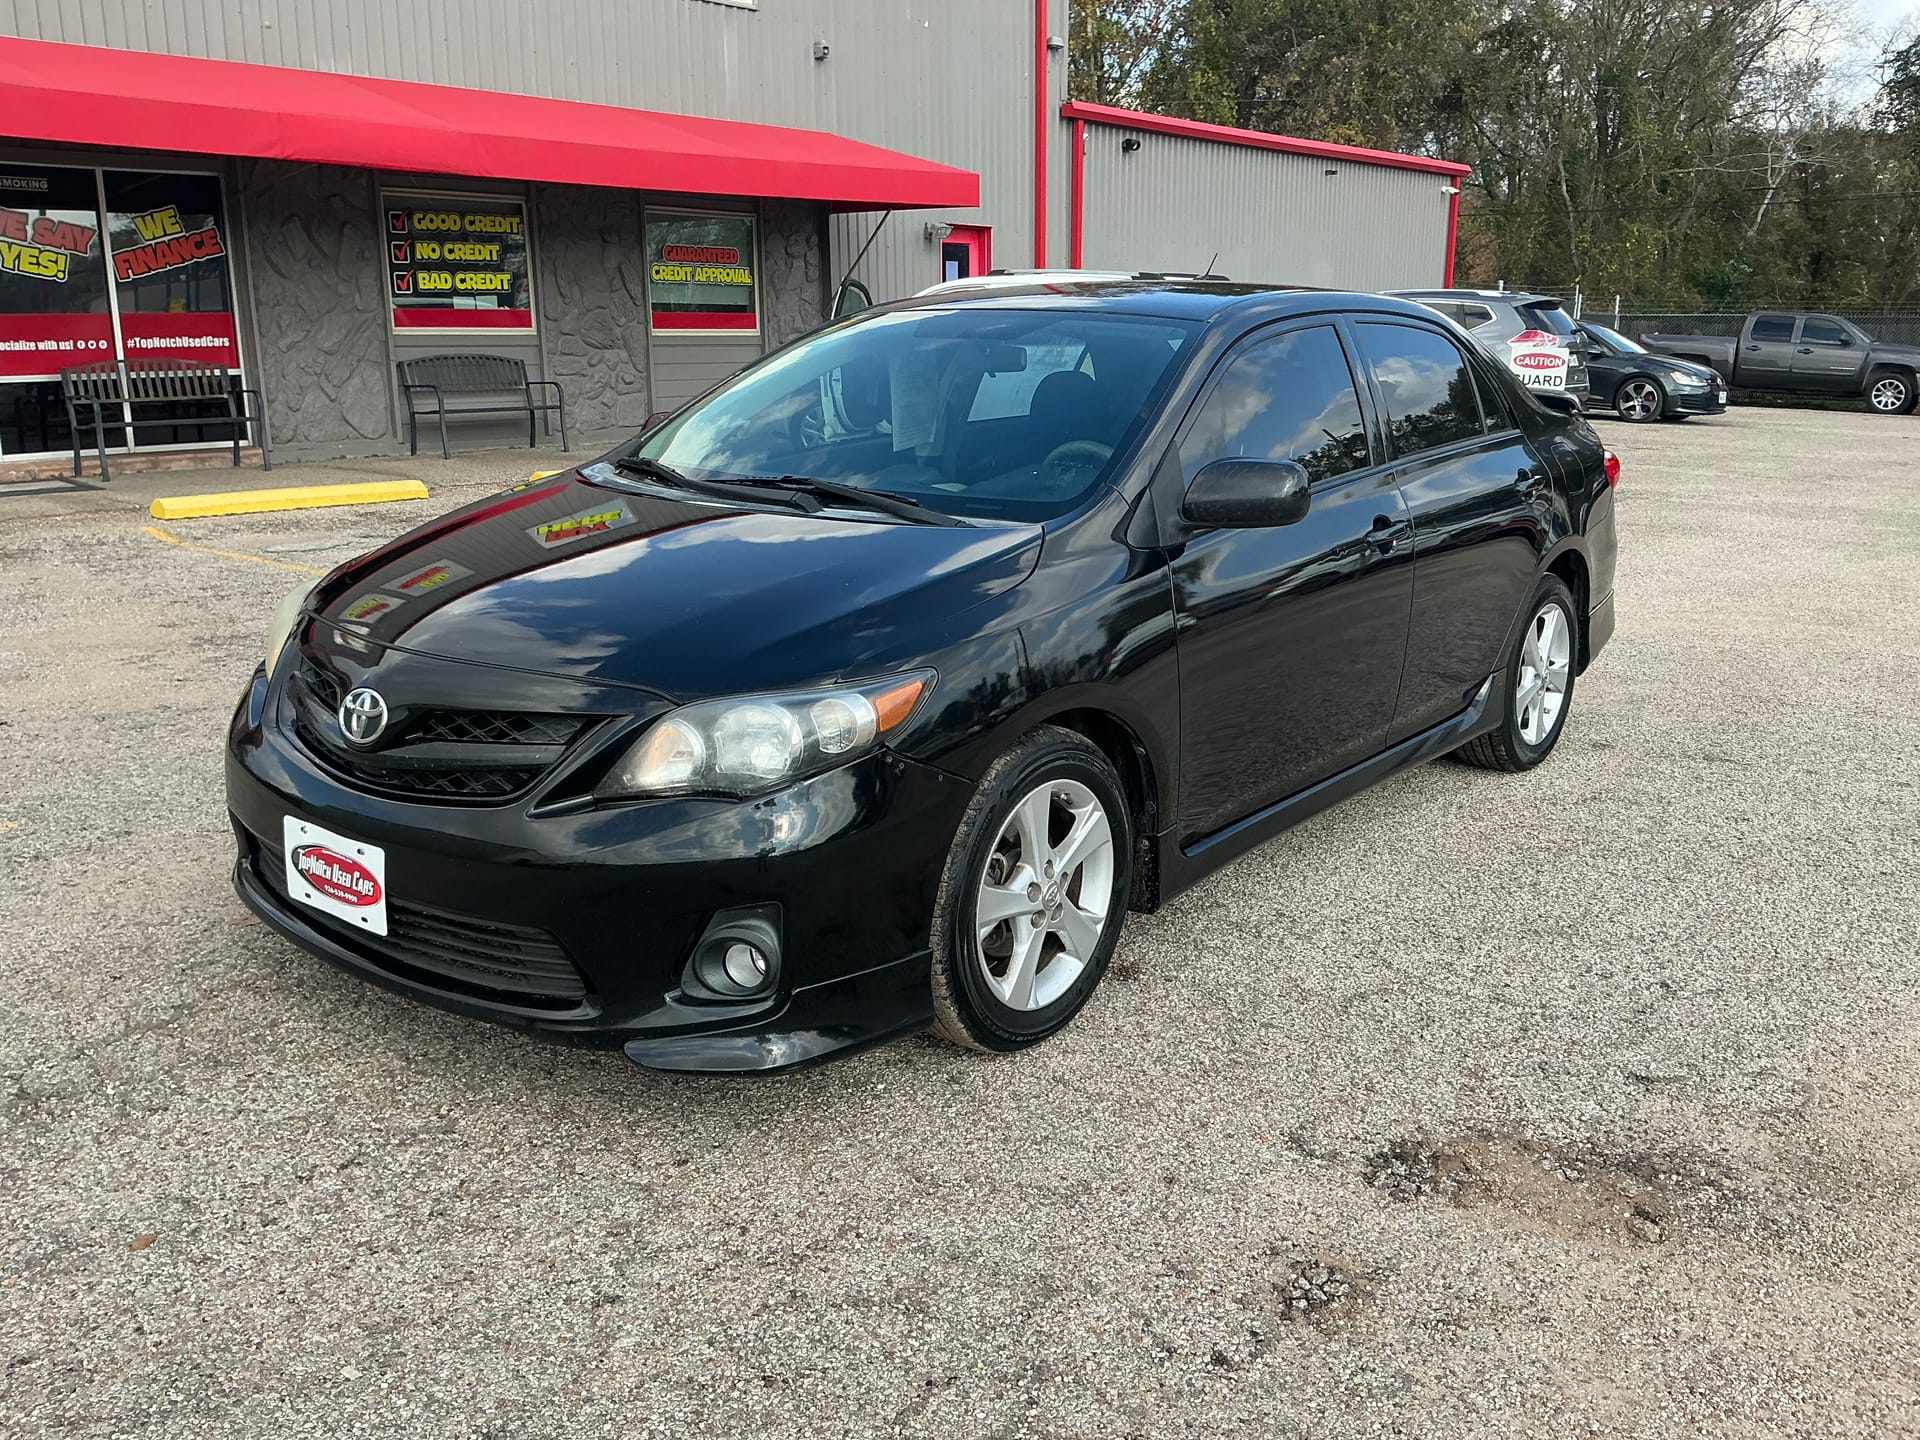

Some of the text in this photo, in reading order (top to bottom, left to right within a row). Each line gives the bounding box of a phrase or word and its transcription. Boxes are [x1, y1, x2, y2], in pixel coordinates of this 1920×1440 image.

[133, 207, 183, 241] WE
[412, 212, 521, 234] GOOD CREDIT
[33, 217, 97, 252] SAY
[0, 241, 67, 281] YES!
[113, 228, 224, 280] FINANCE
[415, 242, 500, 262] NO CREDIT
[664, 245, 738, 264] GUARANTEED
[417, 272, 511, 291] BAD CREDIT
[652, 265, 751, 283] CREDIT APPROVAL
[0, 339, 74, 351] ocialize with us!
[127, 336, 230, 349] #TopNotchUsedCars
[1515, 356, 1563, 367] CAUTION
